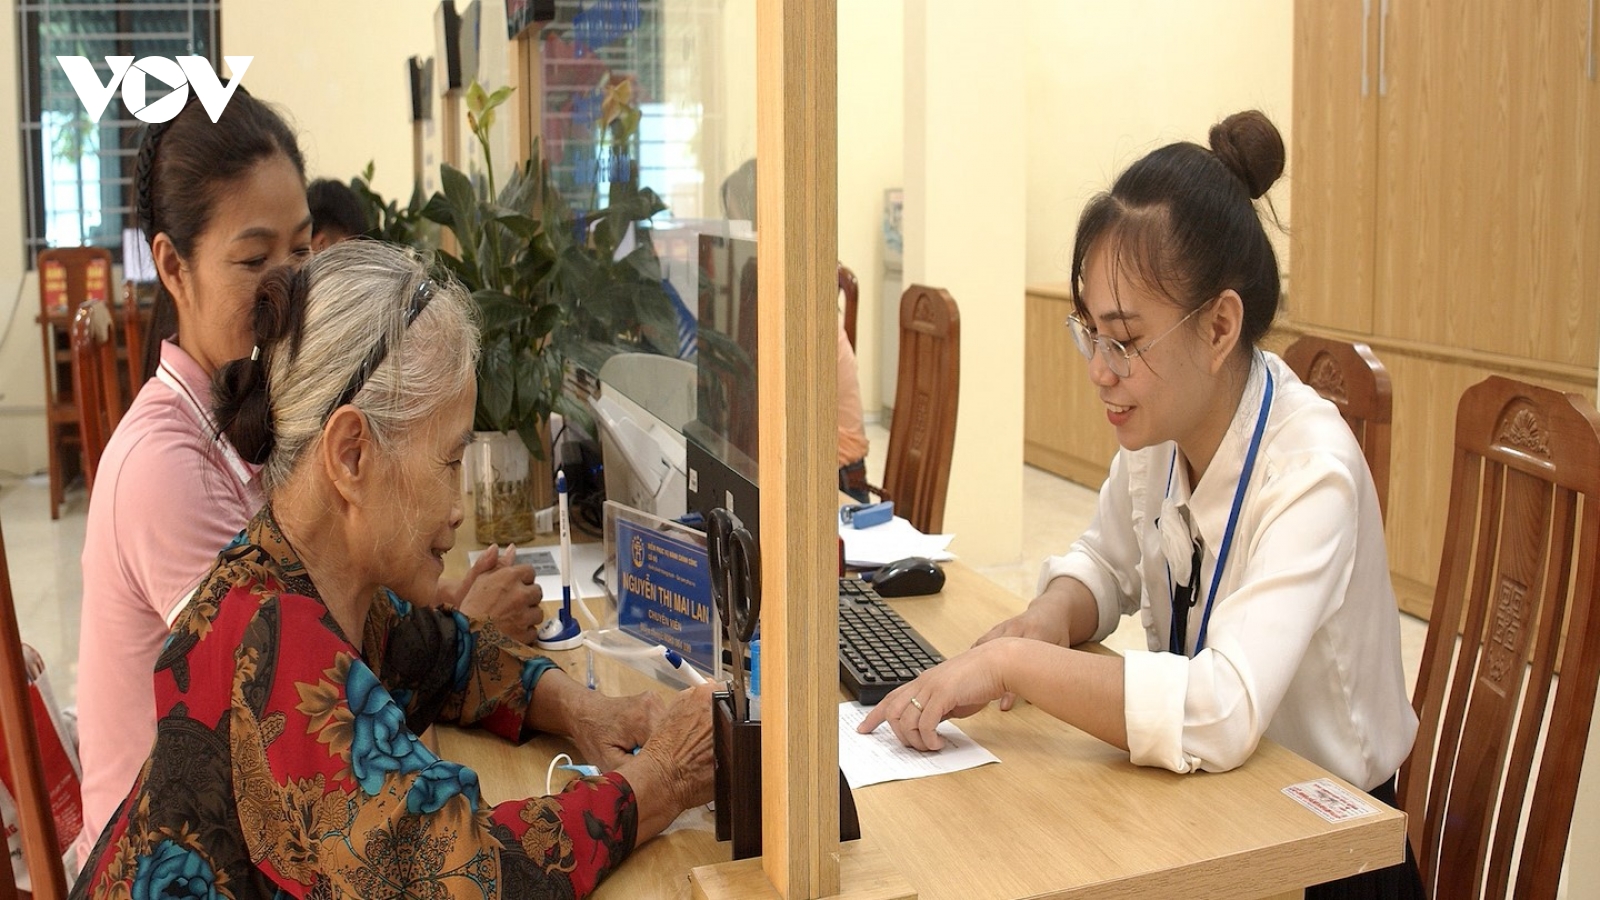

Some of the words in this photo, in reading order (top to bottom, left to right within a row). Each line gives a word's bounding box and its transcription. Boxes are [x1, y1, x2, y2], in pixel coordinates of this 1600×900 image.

[622, 573, 657, 602] NGUYỄN
[657, 586, 672, 612] THỊ
[673, 592, 690, 616] MAI
[691, 600, 709, 624] LAN
[648, 609, 669, 627] CHUYÊN
[669, 618, 682, 632] VIÊN
